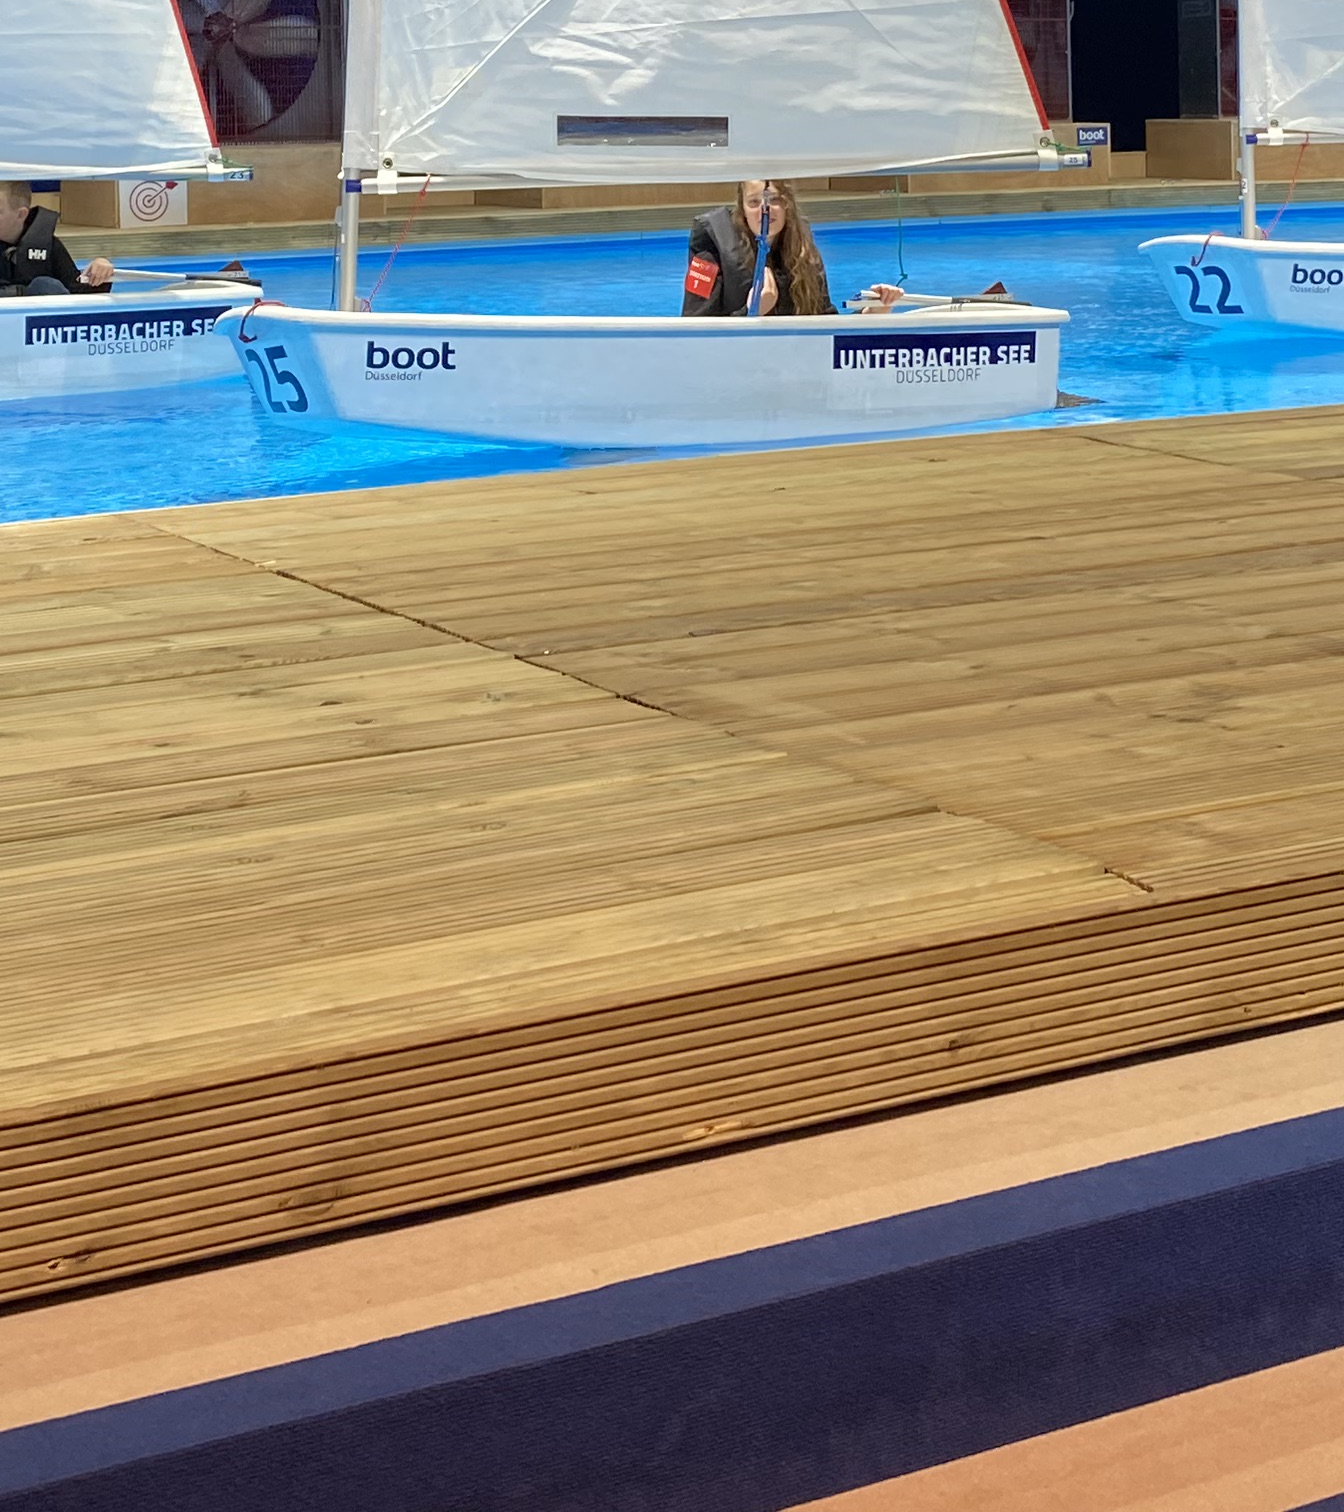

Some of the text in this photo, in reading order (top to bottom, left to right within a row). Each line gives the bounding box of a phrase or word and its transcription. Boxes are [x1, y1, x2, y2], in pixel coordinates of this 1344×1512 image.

[1079, 129, 1105, 140] boot
[229, 171, 244, 180] 23
[1174, 266, 1245, 314] 22
[1290, 285, 1331, 294] Düsseldorf
[31, 316, 222, 345] UNTERBACHER SE
[87, 338, 176, 356] DÜSSELDORF
[366, 340, 457, 370] boot
[840, 344, 1031, 370] UNTERBACHER SEE
[244, 345, 308, 414] 25
[365, 370, 423, 381] Düsseldorf
[896, 367, 982, 384] DÜSSELDORF
